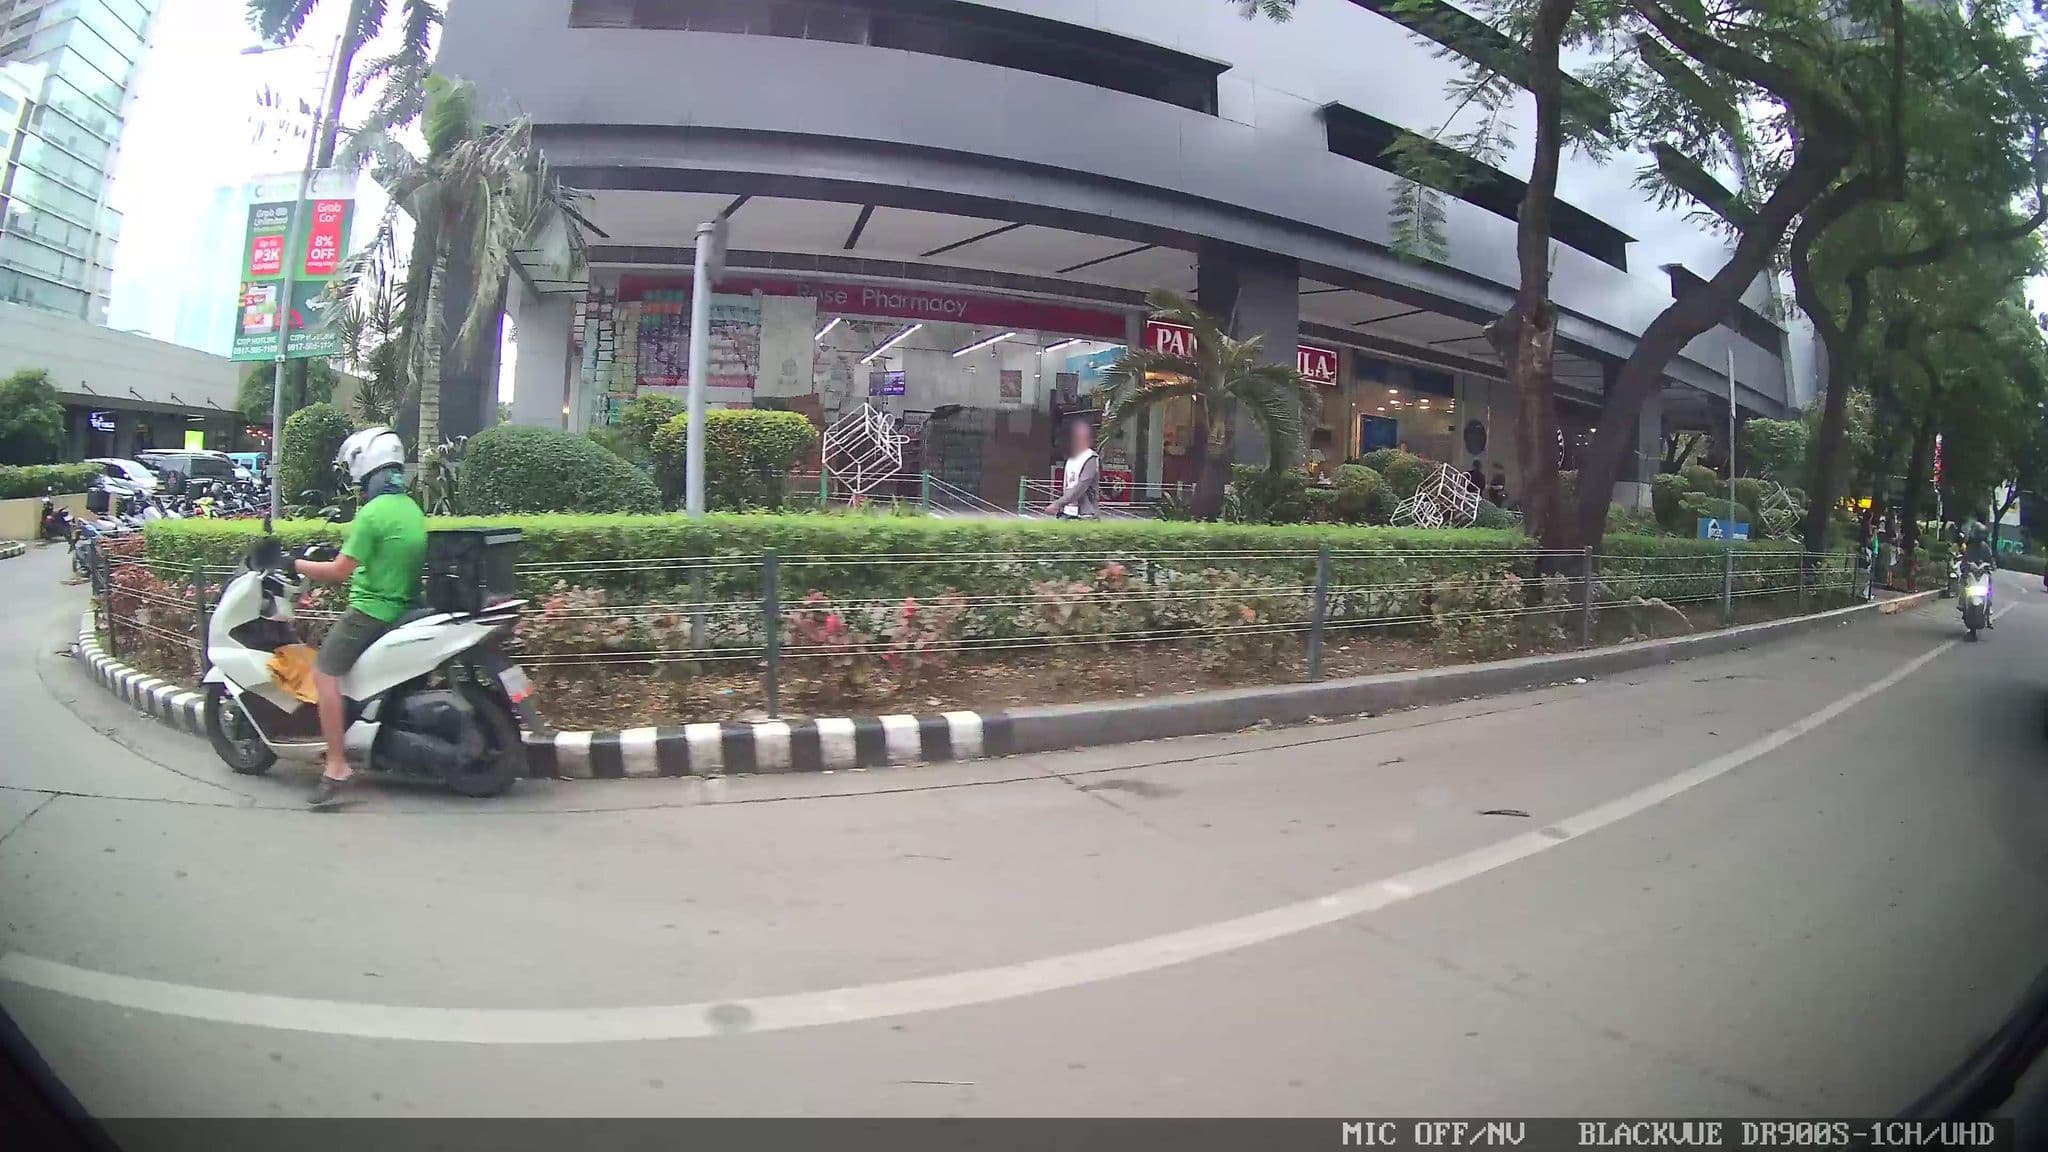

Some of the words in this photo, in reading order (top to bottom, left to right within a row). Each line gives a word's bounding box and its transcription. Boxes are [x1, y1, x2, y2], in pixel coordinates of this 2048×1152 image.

[318, 203, 341, 214] Grab
[319, 213, 336, 223] Car
[315, 235, 334, 248] 8%
[311, 248, 336, 260] OFF
[862, 288, 968, 317] Pharmacy
